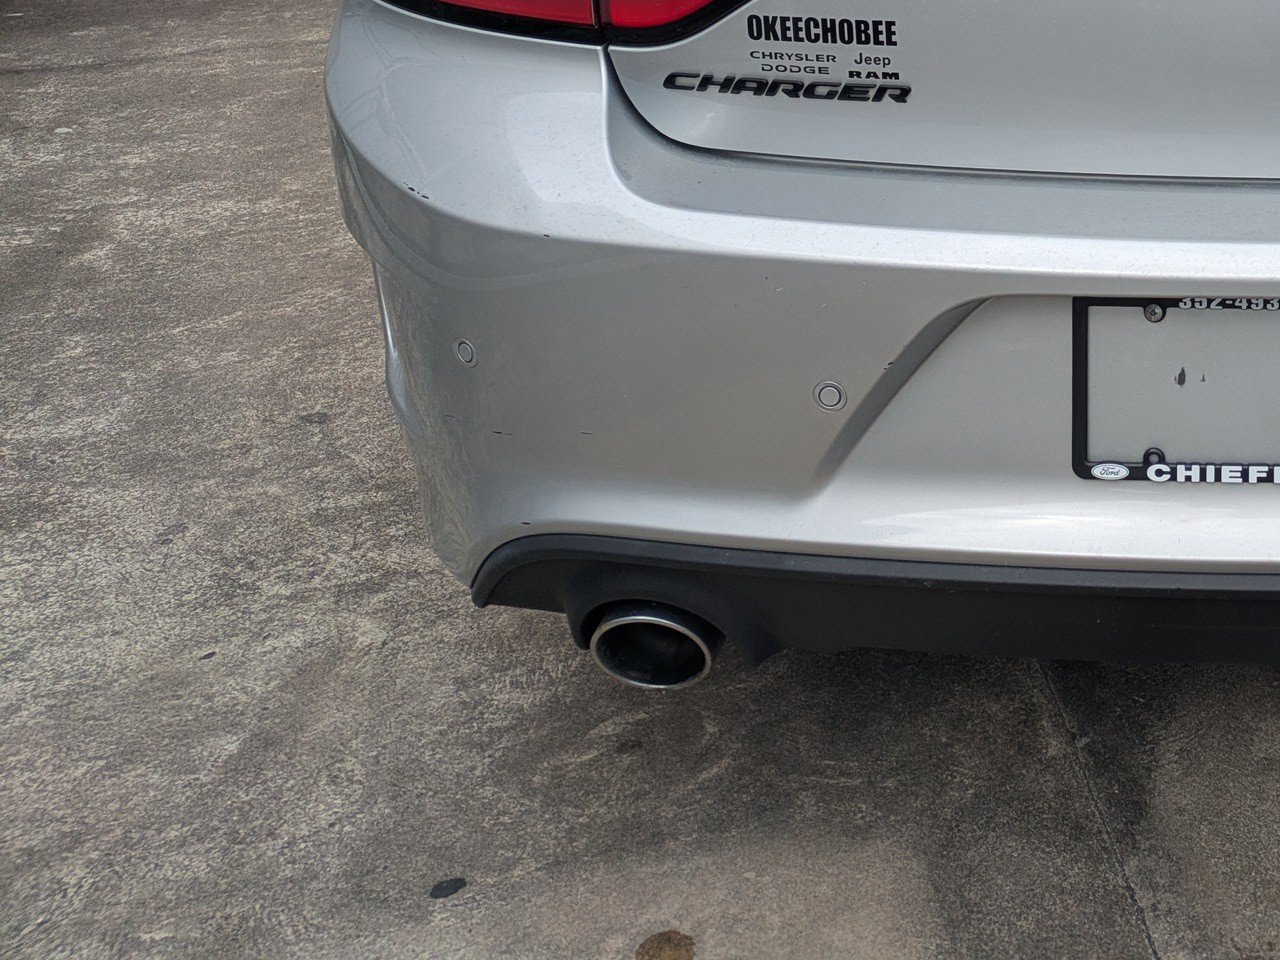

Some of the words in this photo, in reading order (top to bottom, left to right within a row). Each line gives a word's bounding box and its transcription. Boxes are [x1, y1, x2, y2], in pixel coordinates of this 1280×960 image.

[746, 14, 898, 46] OKEECHOBEE
[749, 50, 837, 63] CHRYSLER
[853, 52, 891, 68] Jeep
[760, 63, 830, 75] DODGE
[848, 70, 900, 81] RAM
[662, 71, 912, 103] CHARGER
[1099, 466, 1121, 477] Ford
